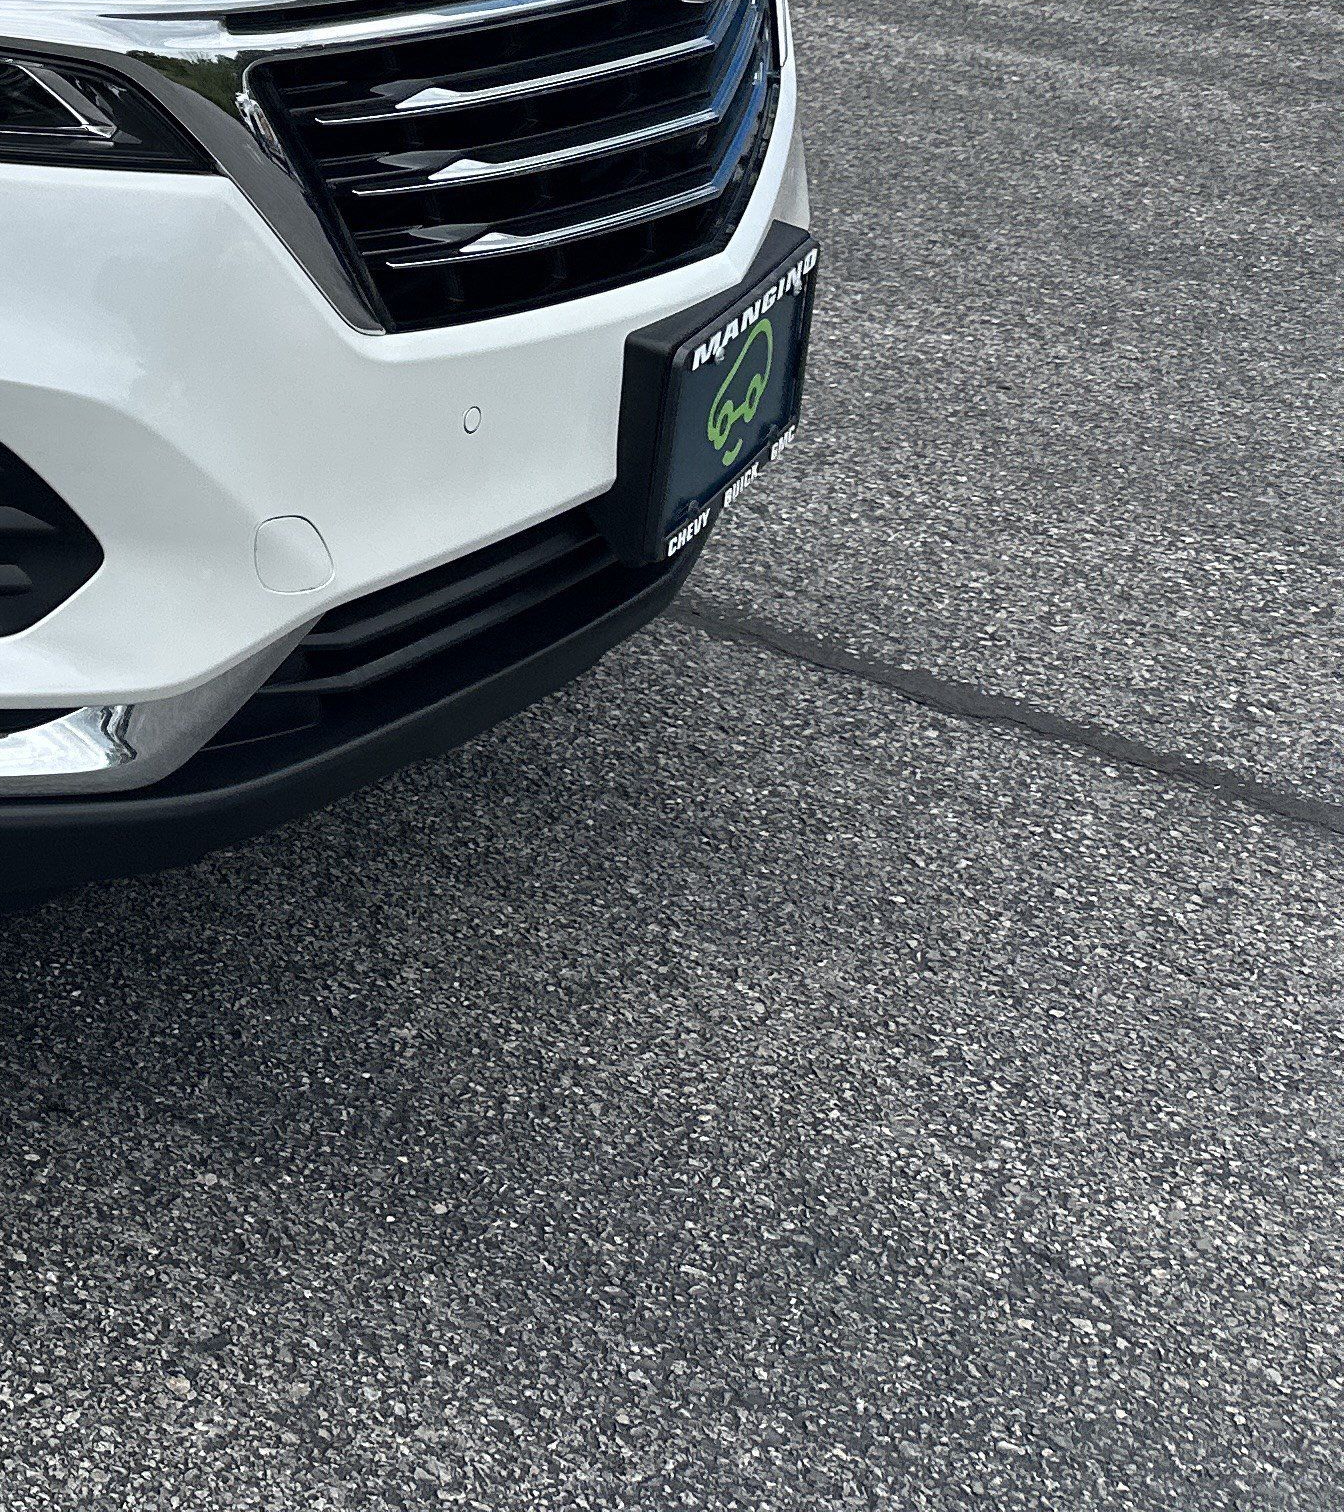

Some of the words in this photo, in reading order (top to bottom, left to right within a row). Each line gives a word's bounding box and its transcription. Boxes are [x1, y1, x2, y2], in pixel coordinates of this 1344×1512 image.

[691, 248, 819, 372] MANGINO
[667, 507, 712, 557] CHEVY
[723, 461, 760, 508] BUICK
[770, 424, 796, 461] GMC
